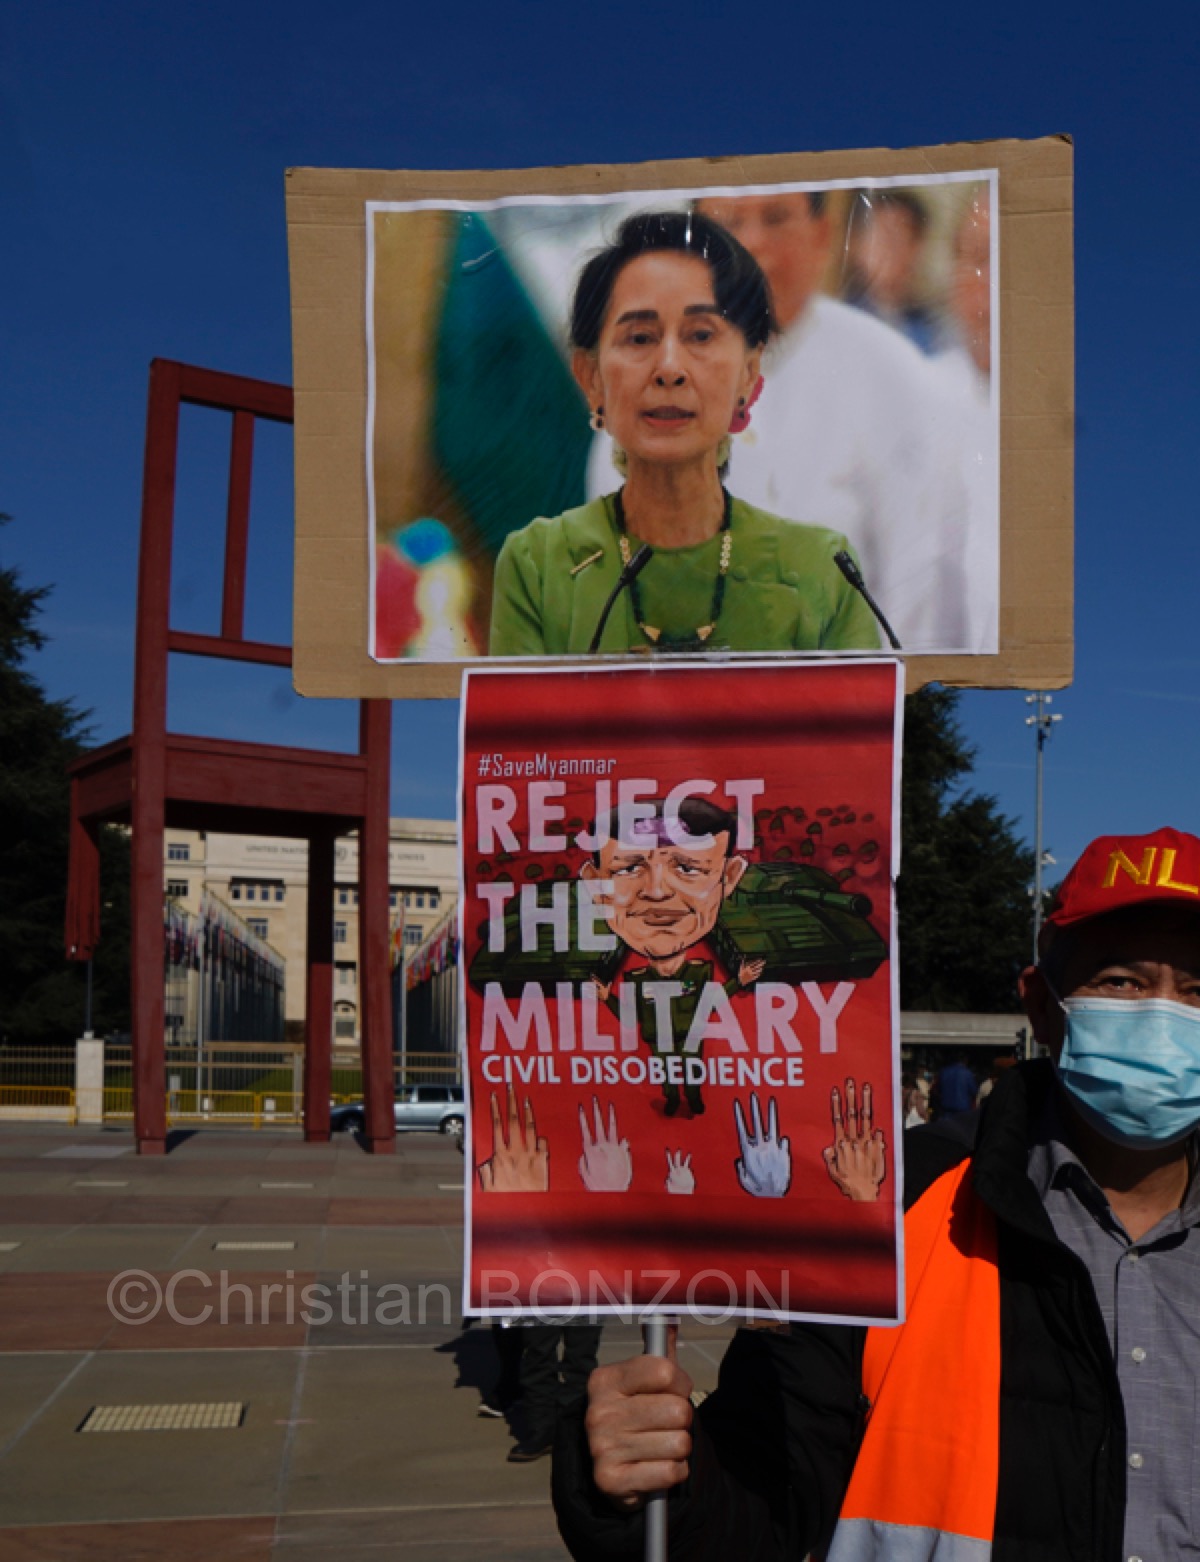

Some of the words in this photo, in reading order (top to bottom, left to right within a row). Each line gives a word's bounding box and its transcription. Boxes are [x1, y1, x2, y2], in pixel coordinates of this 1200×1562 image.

[478, 753, 617, 781] #SaveMyanmar
[476, 778, 765, 853] REJECT
[477, 879, 618, 954] THE
[480, 981, 857, 1054] MILITARY
[481, 1054, 561, 1084] CIVIL
[571, 1055, 804, 1087] DISOBEDIENCE
